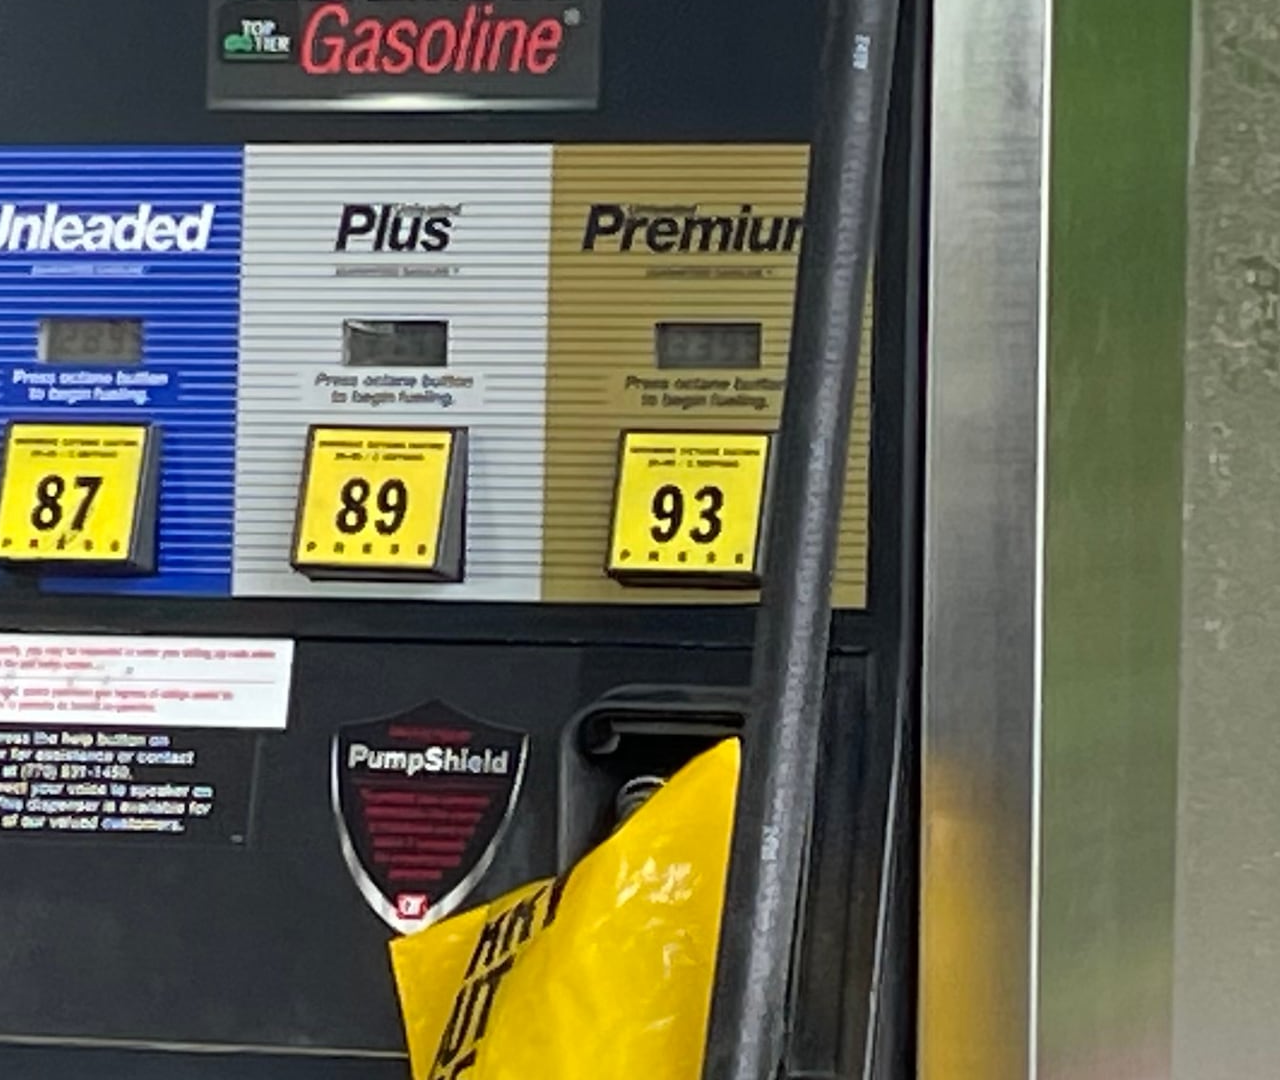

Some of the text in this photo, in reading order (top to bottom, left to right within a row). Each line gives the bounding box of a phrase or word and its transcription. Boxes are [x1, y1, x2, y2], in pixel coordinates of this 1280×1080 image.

[300, 3, 564, 74] Gasoline
[334, 203, 453, 252] Plus
[31, 474, 104, 531] 87
[335, 477, 408, 536] 89
[650, 483, 724, 544] 93
[348, 743, 509, 777] PumpShield
